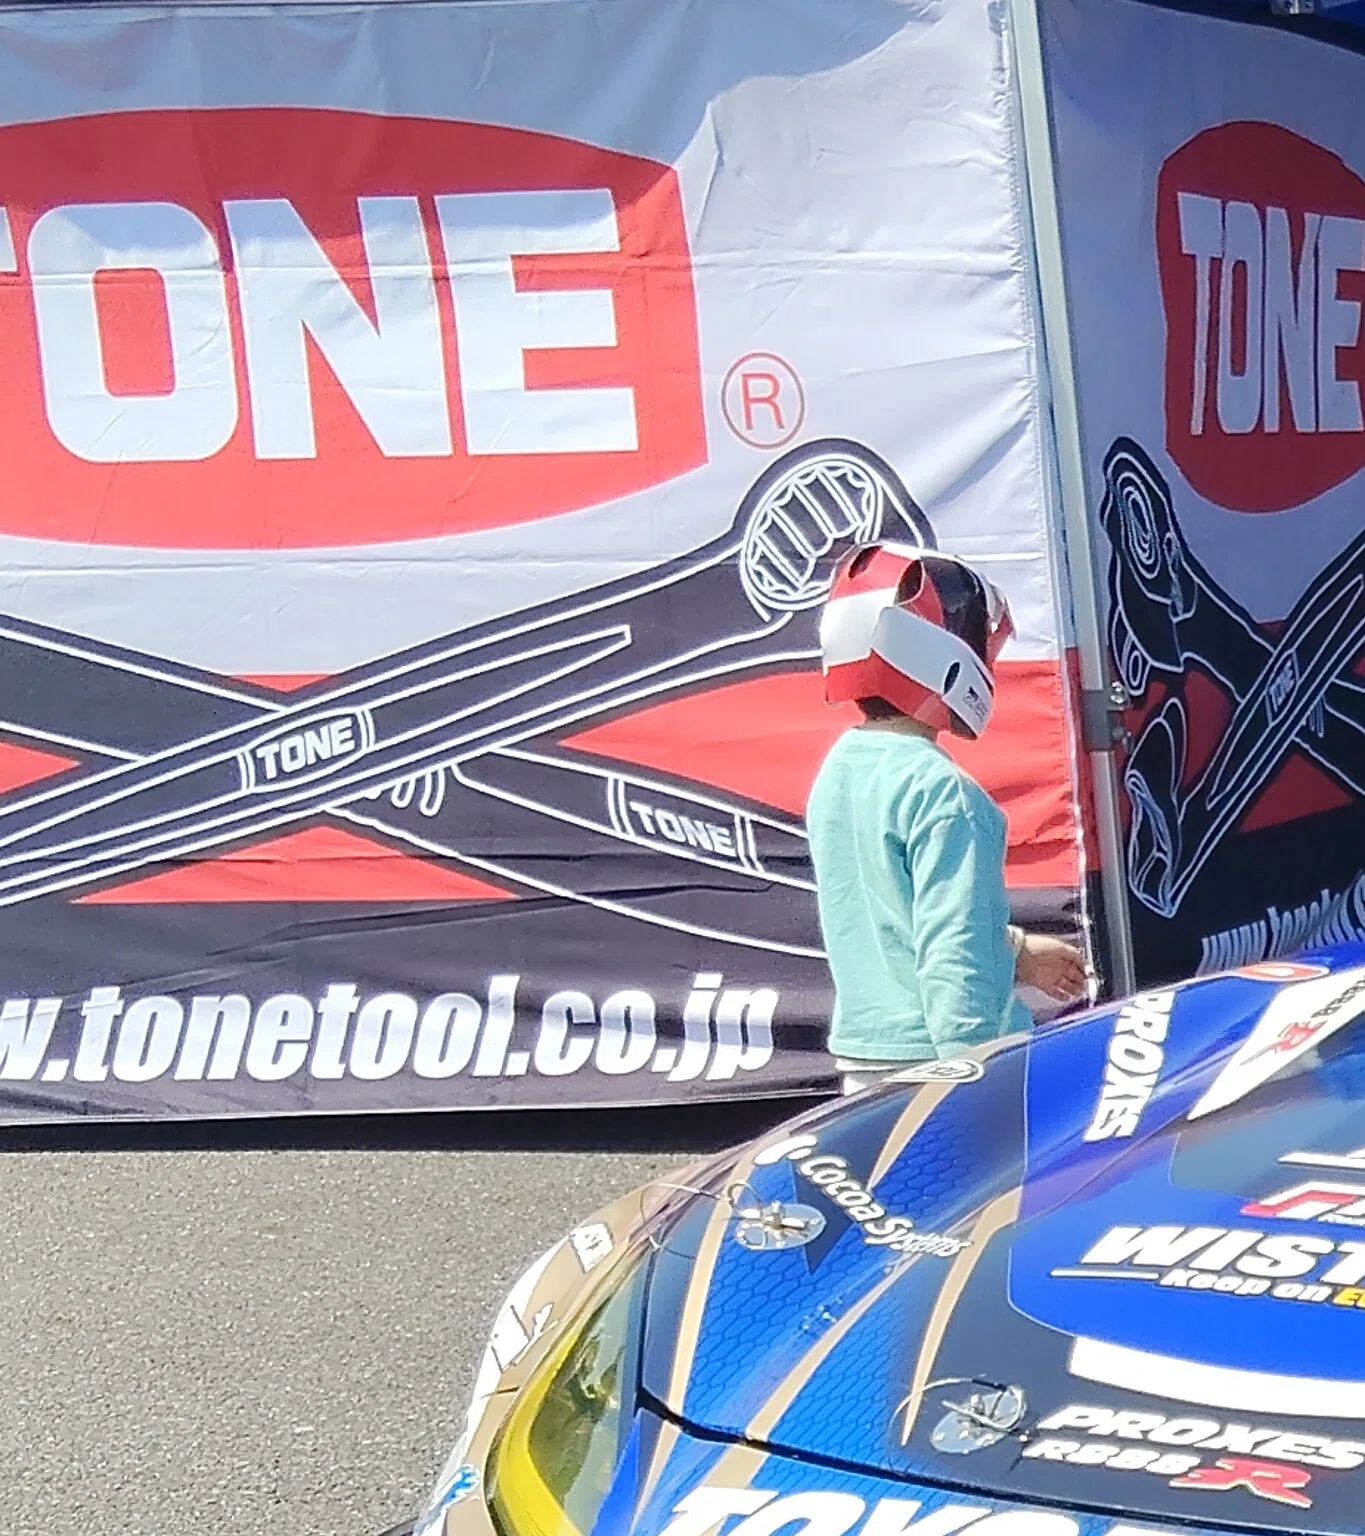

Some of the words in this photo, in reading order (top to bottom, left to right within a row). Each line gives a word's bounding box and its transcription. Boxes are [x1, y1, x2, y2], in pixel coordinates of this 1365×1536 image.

[0, 187, 638, 463] ONE
[256, 717, 356, 782] TONE
[630, 800, 735, 855] TONE
[1282, 1275, 1333, 1305] on
